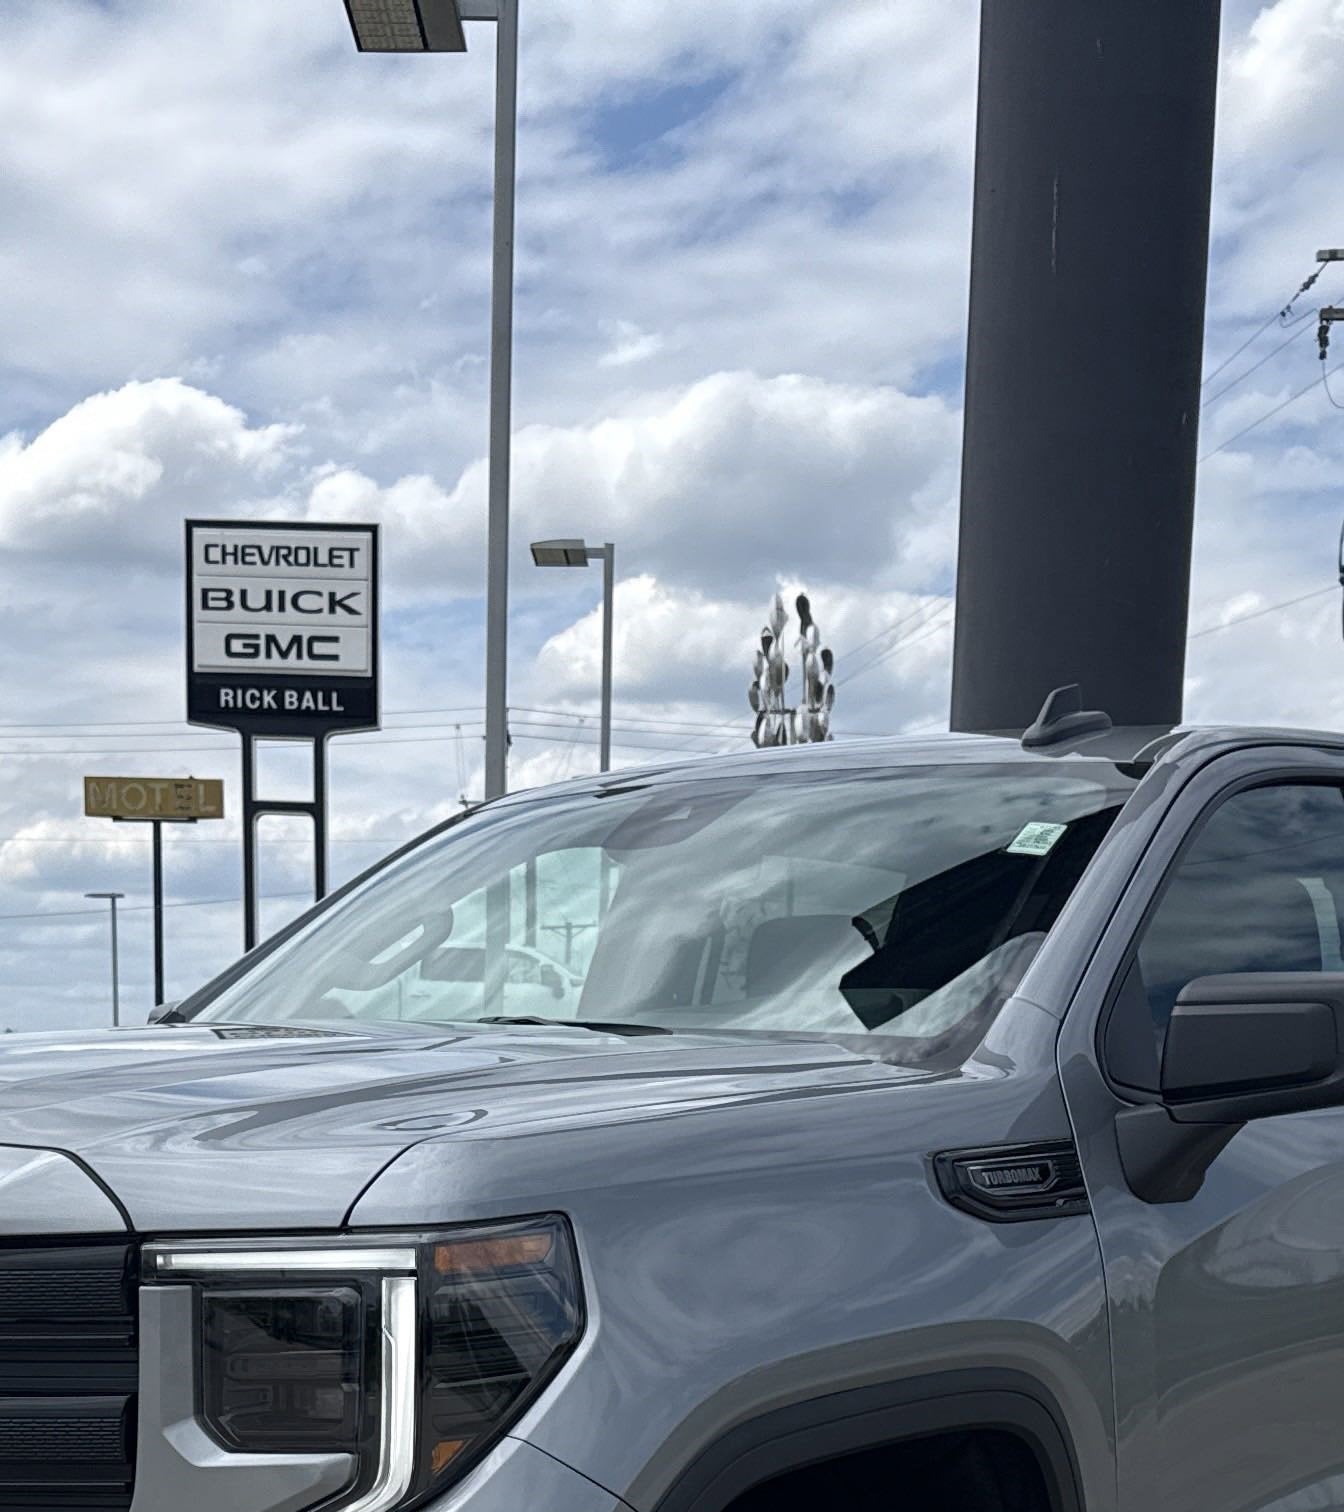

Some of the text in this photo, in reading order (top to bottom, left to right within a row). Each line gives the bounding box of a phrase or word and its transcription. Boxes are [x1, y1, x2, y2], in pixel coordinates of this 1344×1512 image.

[204, 543, 361, 568] CHEVROLET
[201, 588, 363, 616] BUICK
[224, 633, 341, 662] GMC
[219, 687, 344, 712] RICK BALL
[982, 1167, 1042, 1186] TURBOMAX
